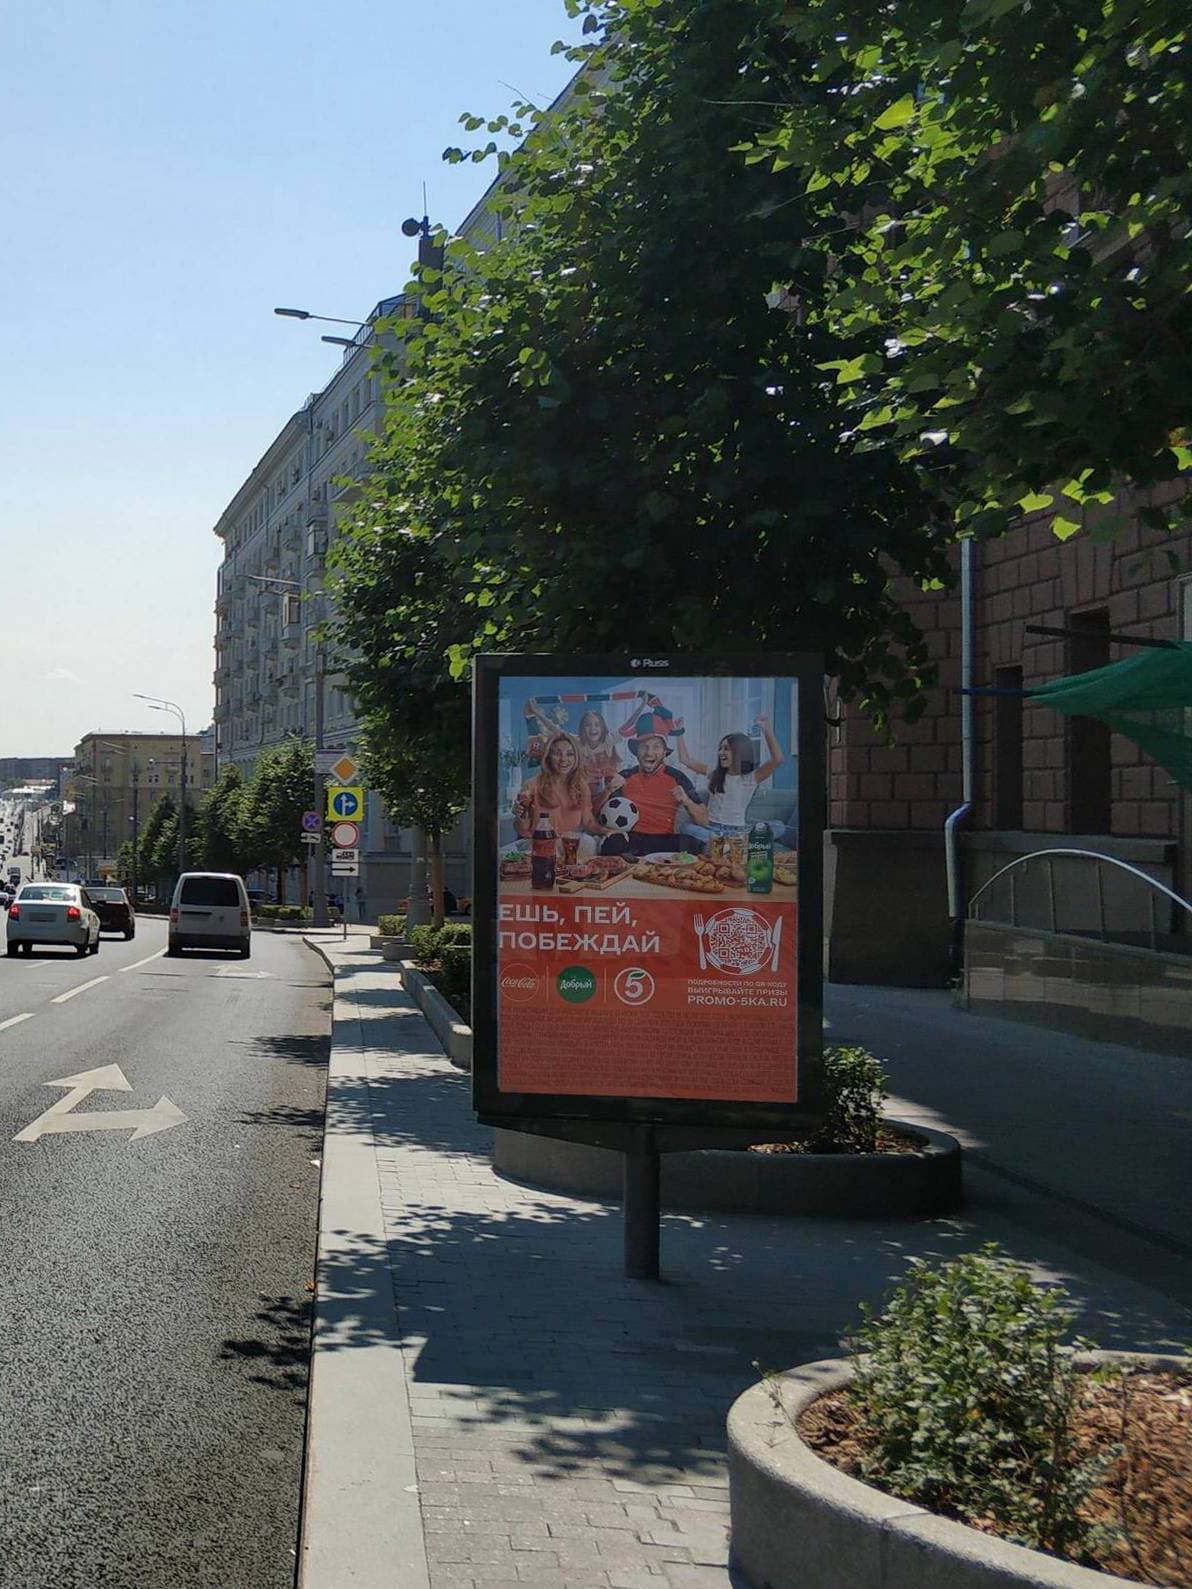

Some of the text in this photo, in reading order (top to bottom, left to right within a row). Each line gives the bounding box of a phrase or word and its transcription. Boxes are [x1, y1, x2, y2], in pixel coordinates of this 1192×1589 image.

[498, 901, 638, 927] ЕШЬ, ПЕЙ,
[498, 930, 660, 956] ПОБЕЖДАЙ
[624, 971, 648, 999] 5
[688, 987, 788, 996] ВЫИГРЫВАЙТЕ ПРИЗЫ
[688, 995, 787, 1007] PROMO-5KA.RU
